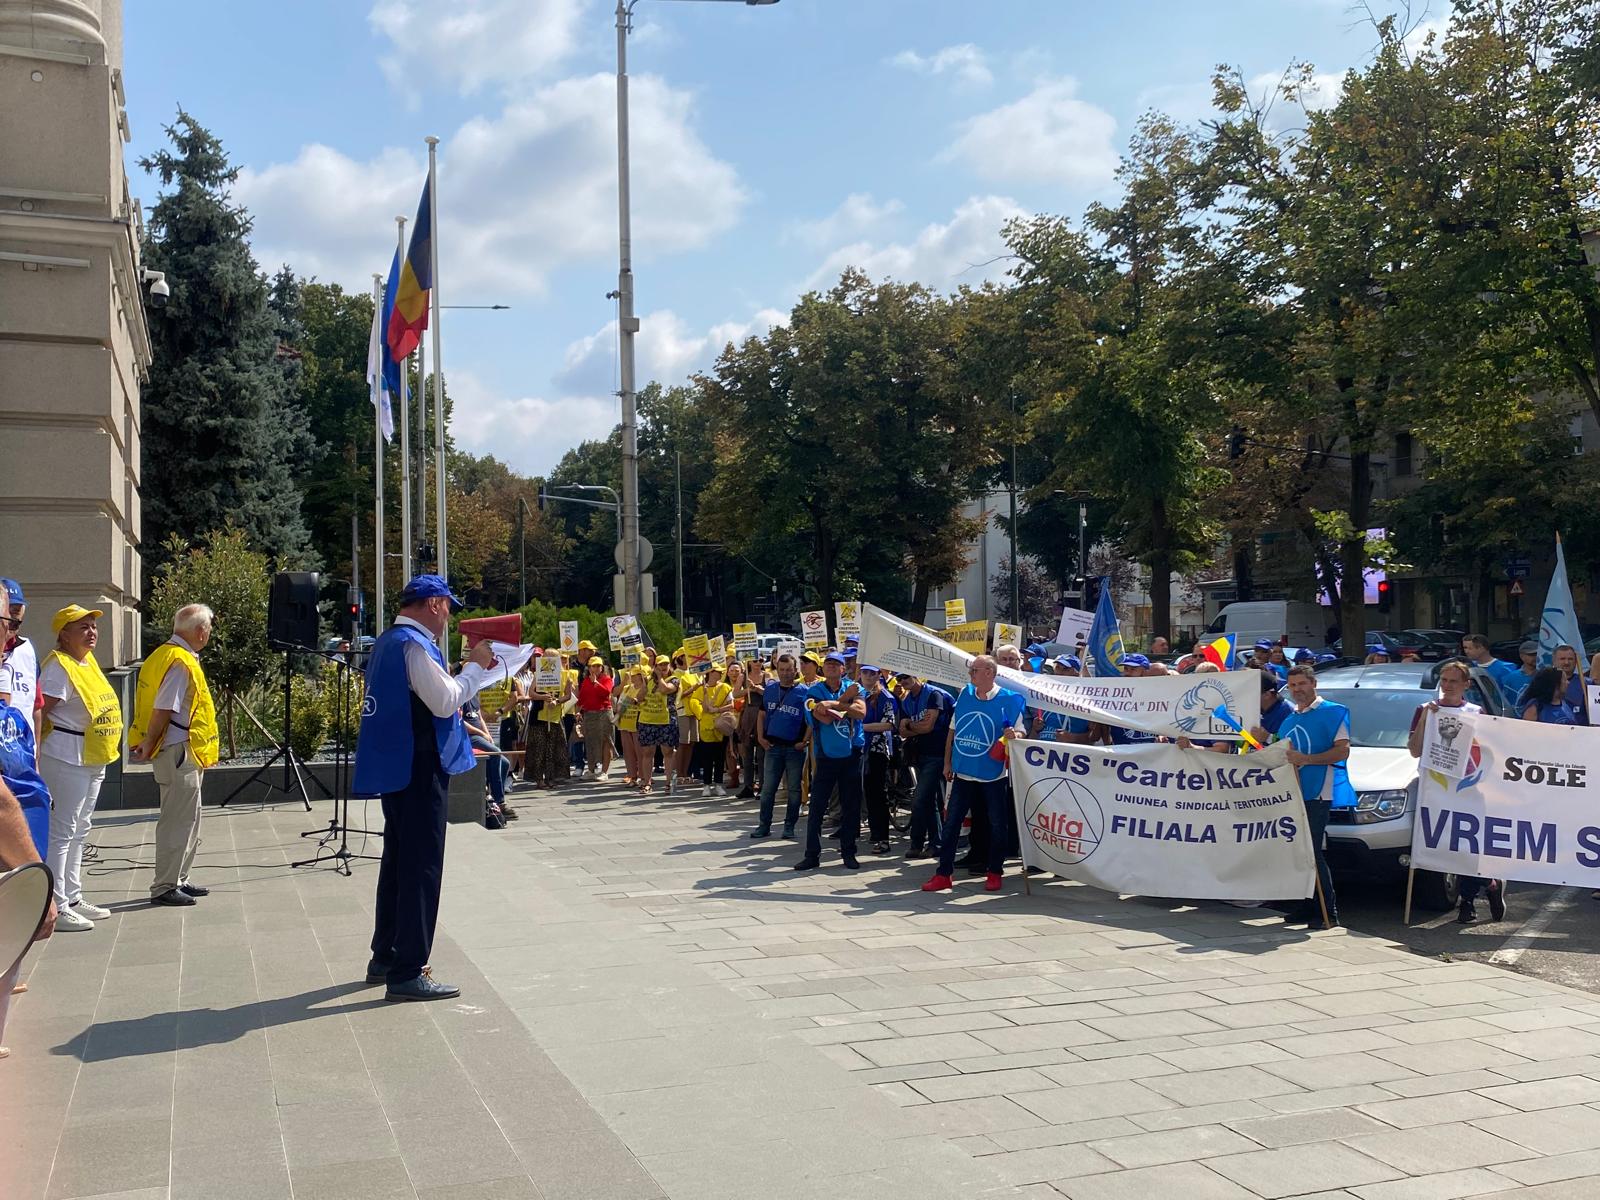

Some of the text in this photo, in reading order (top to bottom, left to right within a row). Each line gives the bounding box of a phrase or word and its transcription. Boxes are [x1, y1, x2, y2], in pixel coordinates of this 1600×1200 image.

[1074, 685, 1110, 698] LIBER
[1111, 687, 1135, 698] DIN
[1147, 701, 1169, 712] DIN
[1215, 724, 1236, 733] UP
[959, 740, 981, 751] CARTEL
[1024, 745, 1091, 776] CNS
[1102, 758, 1212, 791] "Cartel
[1503, 756, 1586, 788] SOLE
[1114, 793, 1169, 809] UNIUNEA
[1037, 810, 1084, 839] alfa
[1111, 814, 1217, 844] FILIALA
[1420, 806, 1557, 864] VREM
[1032, 826, 1087, 856] CARTEL
